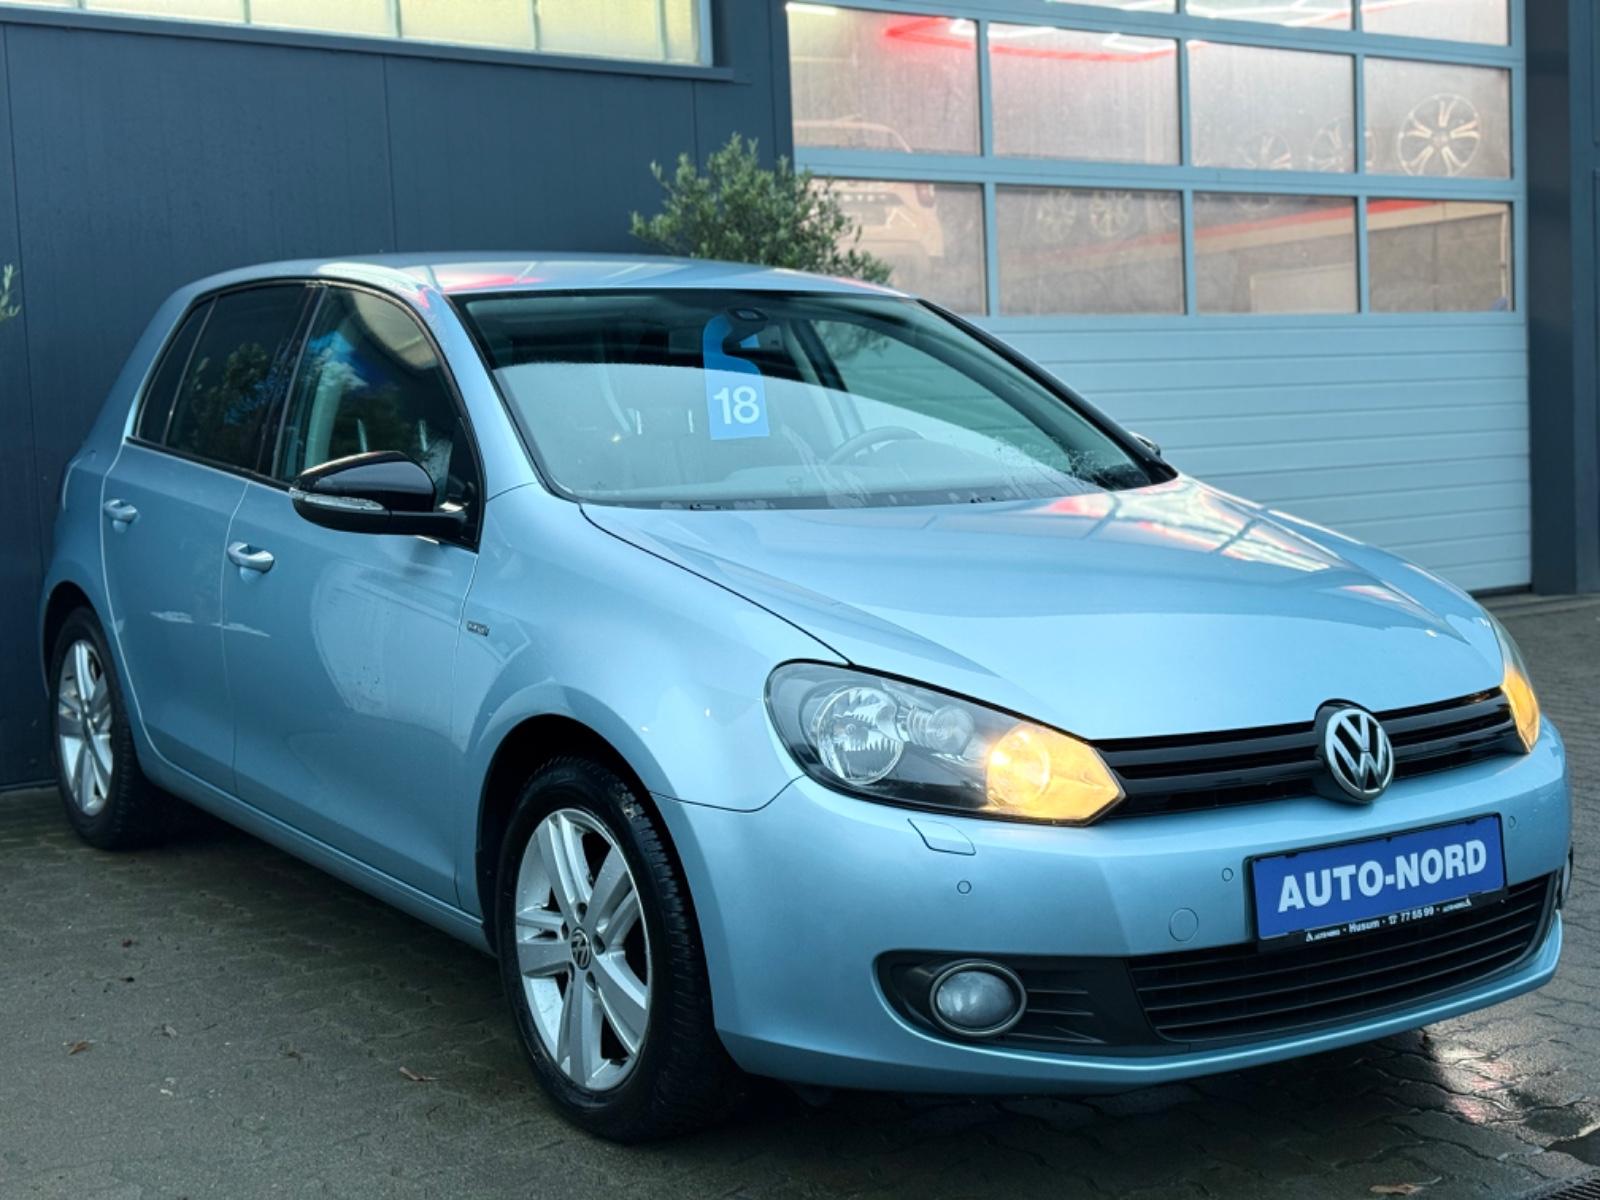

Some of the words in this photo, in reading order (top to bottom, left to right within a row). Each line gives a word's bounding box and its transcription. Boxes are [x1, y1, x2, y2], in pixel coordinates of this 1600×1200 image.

[713, 386, 760, 425] 18
[1325, 708, 1393, 799] VW
[1277, 839, 1487, 914] AUTO-NORD
[1348, 919, 1381, 934] Husum
